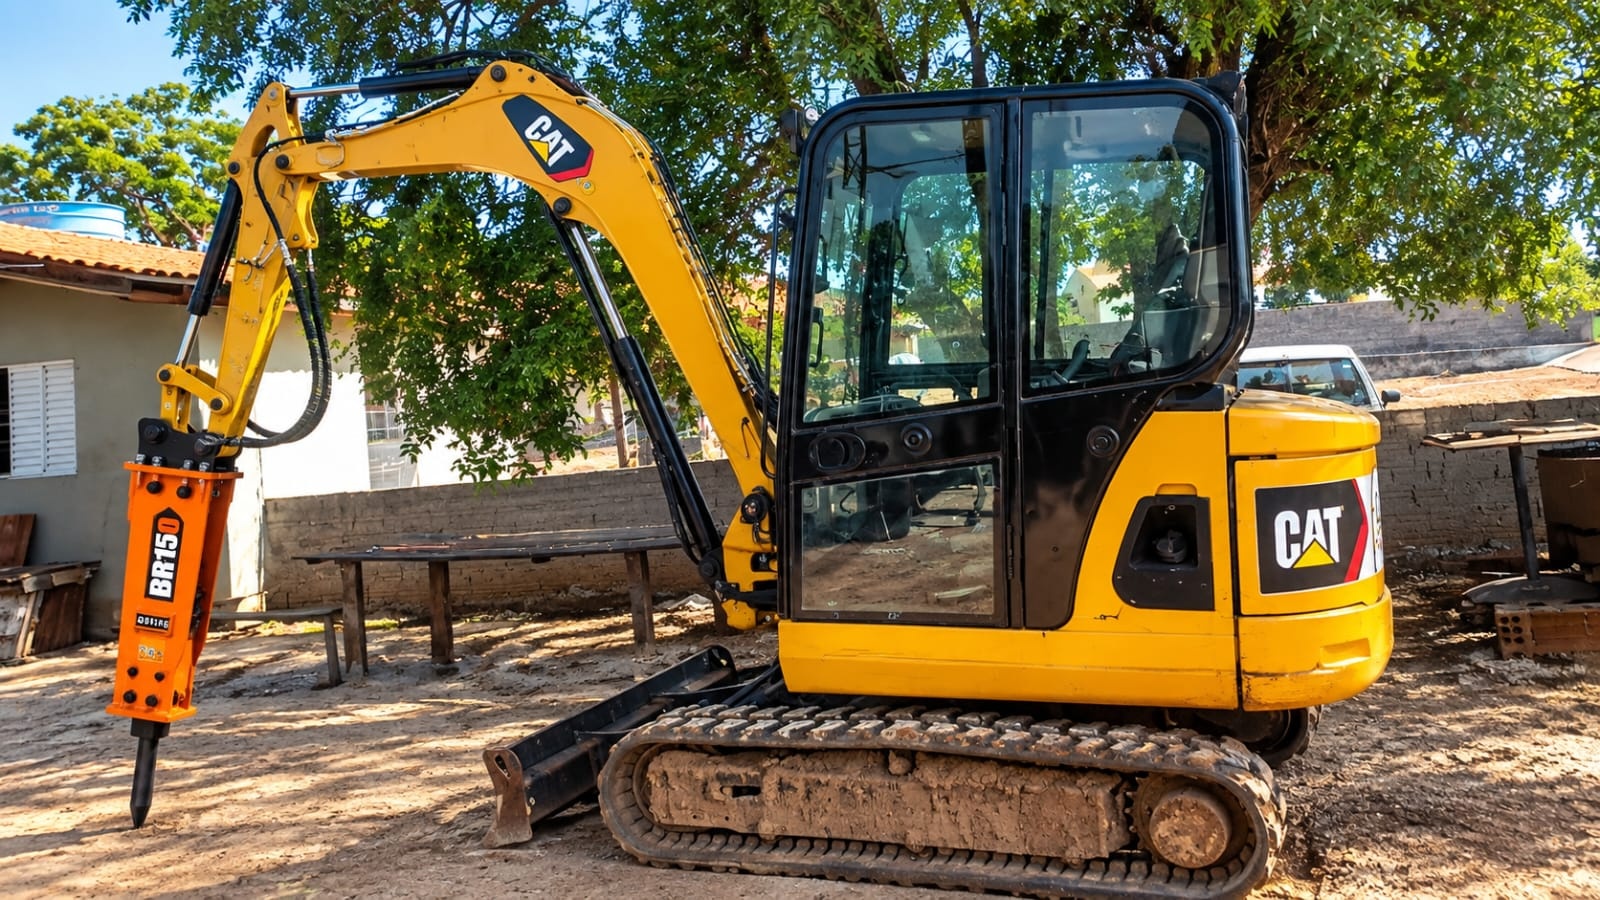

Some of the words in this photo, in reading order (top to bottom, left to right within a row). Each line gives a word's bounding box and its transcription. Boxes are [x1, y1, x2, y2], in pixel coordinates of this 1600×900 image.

[524, 115, 575, 167] CAT
[148, 517, 180, 599] BR150
[1274, 506, 1342, 568] CAT
